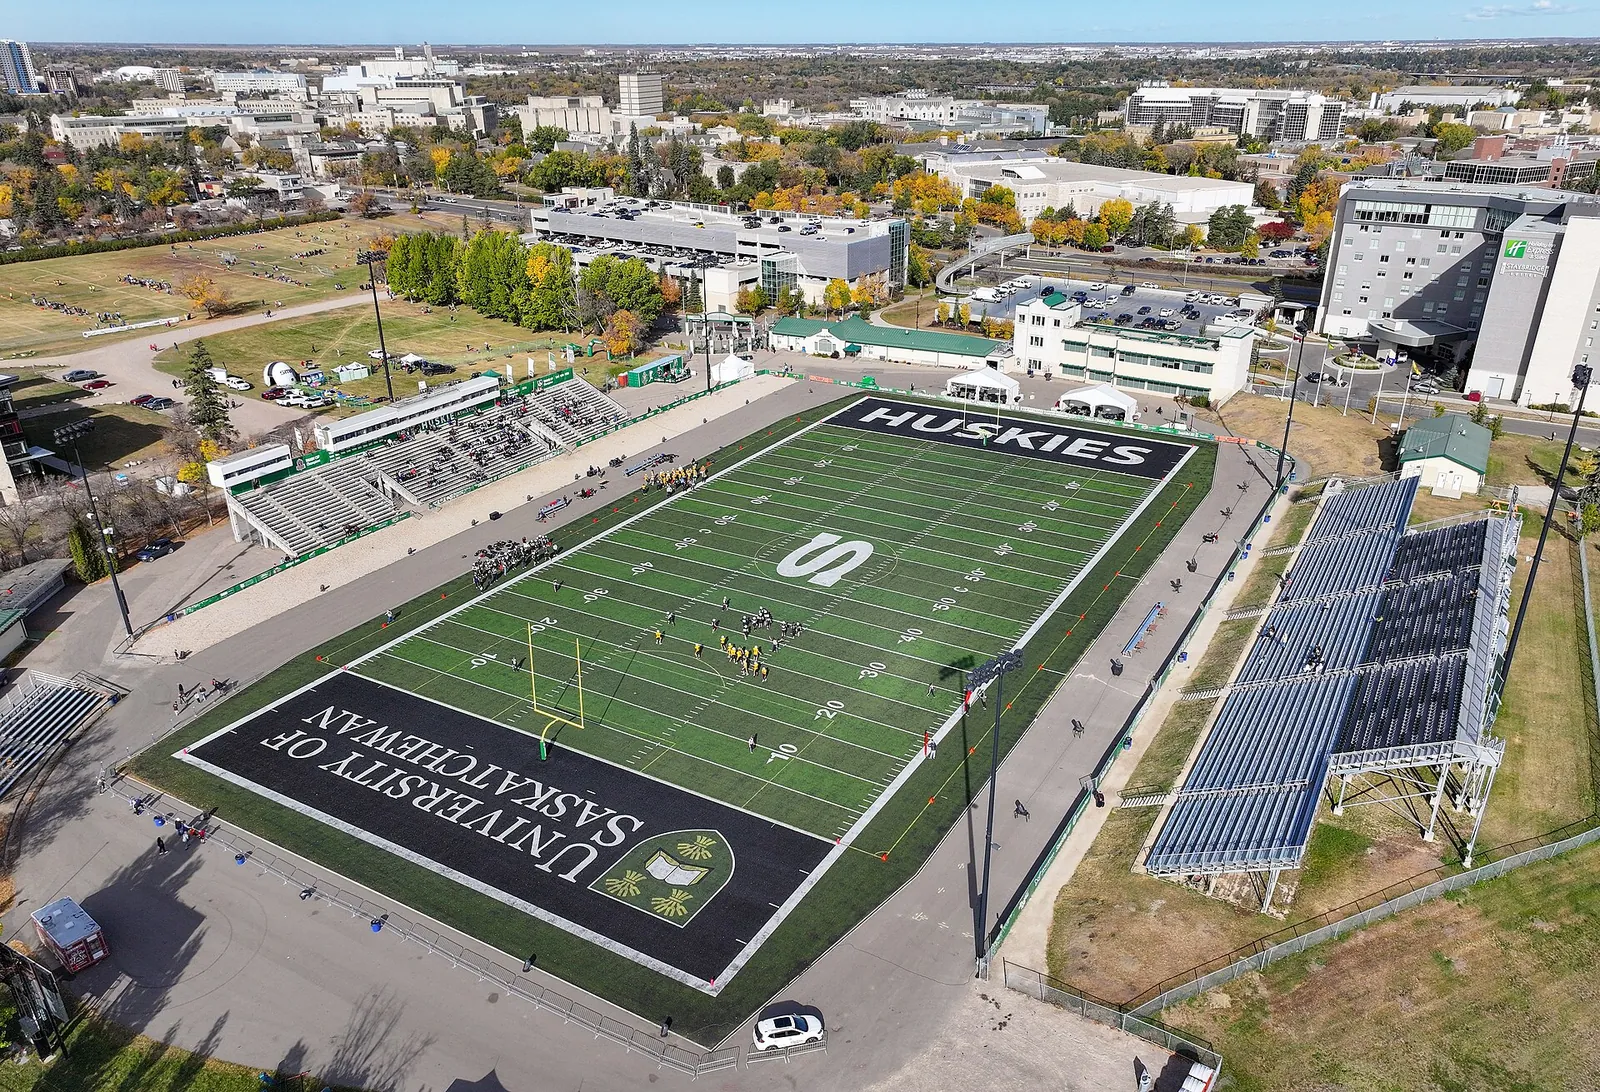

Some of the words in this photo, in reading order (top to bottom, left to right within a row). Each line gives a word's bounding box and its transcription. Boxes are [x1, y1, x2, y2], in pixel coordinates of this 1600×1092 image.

[1527, 246, 1554, 255] Express
[1505, 262, 1545, 272] STAYBRIDGE
[859, 407, 1153, 465] HUSKIES
[1018, 520, 1037, 533] 30
[994, 543, 1013, 557] 40
[776, 532, 874, 587] S
[632, 561, 654, 574] 40
[964, 569, 986, 582] 50
[584, 588, 609, 601] 30
[954, 586, 969, 594] C
[936, 597, 957, 611] 50
[530, 616, 558, 633] 20
[901, 628, 923, 643] 40
[471, 651, 498, 667] 10
[861, 662, 887, 678] 30
[818, 700, 845, 719] 20
[261, 730, 328, 758] OF
[772, 743, 797, 760] 10
[301, 704, 645, 848] SASKATCHEWAN
[318, 751, 598, 884] UNIVERSITY
